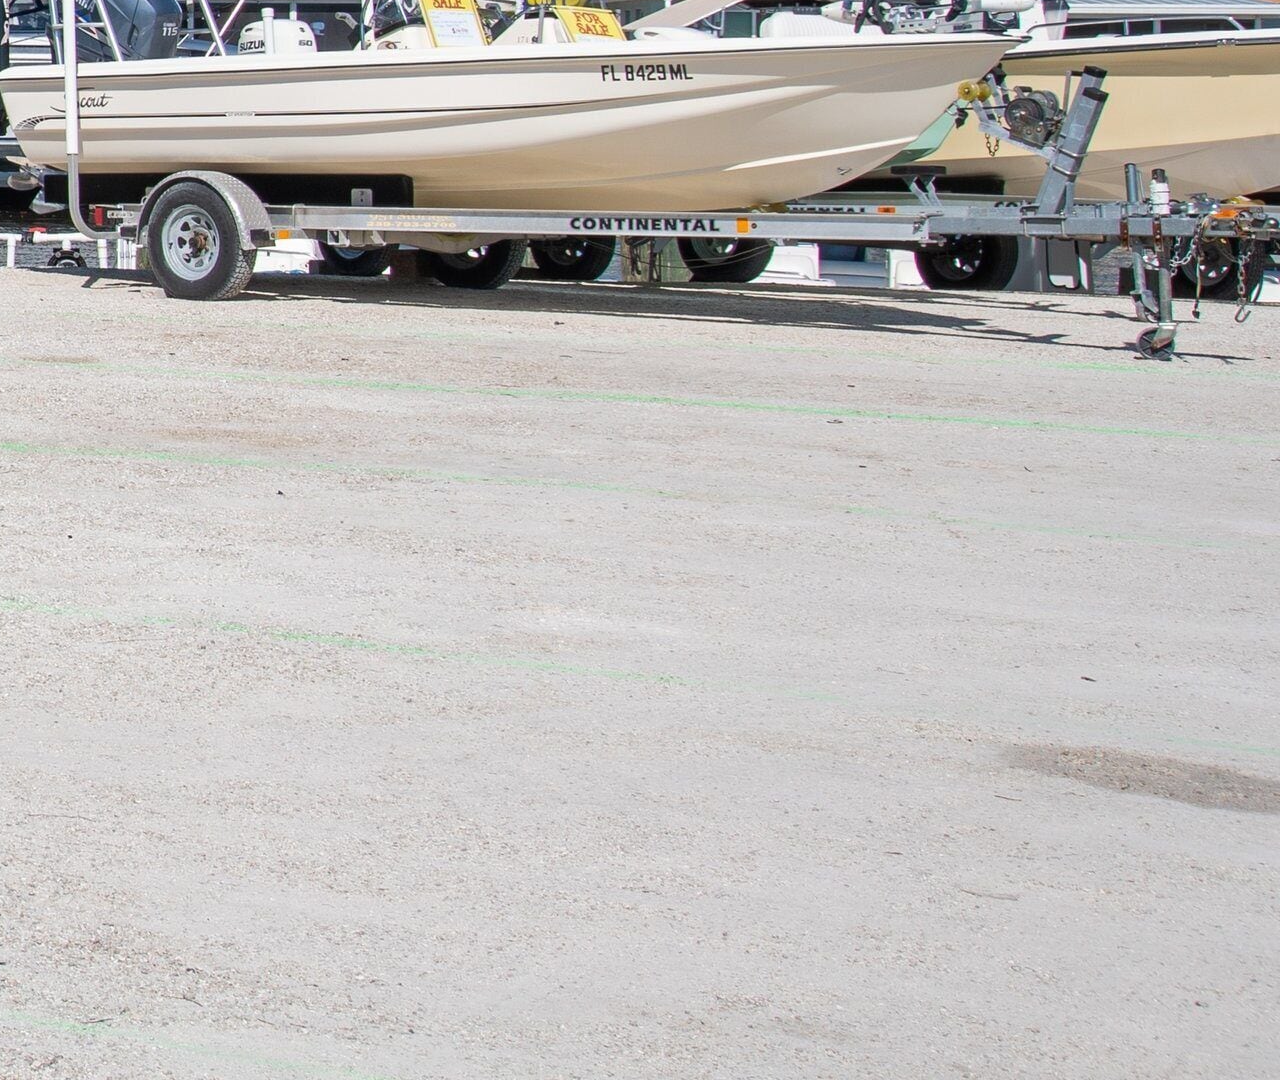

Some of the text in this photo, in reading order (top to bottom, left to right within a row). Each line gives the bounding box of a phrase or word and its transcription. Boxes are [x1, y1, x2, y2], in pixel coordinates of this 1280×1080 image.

[573, 11, 603, 26] FOR
[162, 26, 178, 36] 115
[576, 22, 614, 37] SALE
[240, 40, 265, 52] SUZUK
[601, 63, 694, 81] FL 8429 ML
[569, 217, 721, 232] CONTINENTAL
